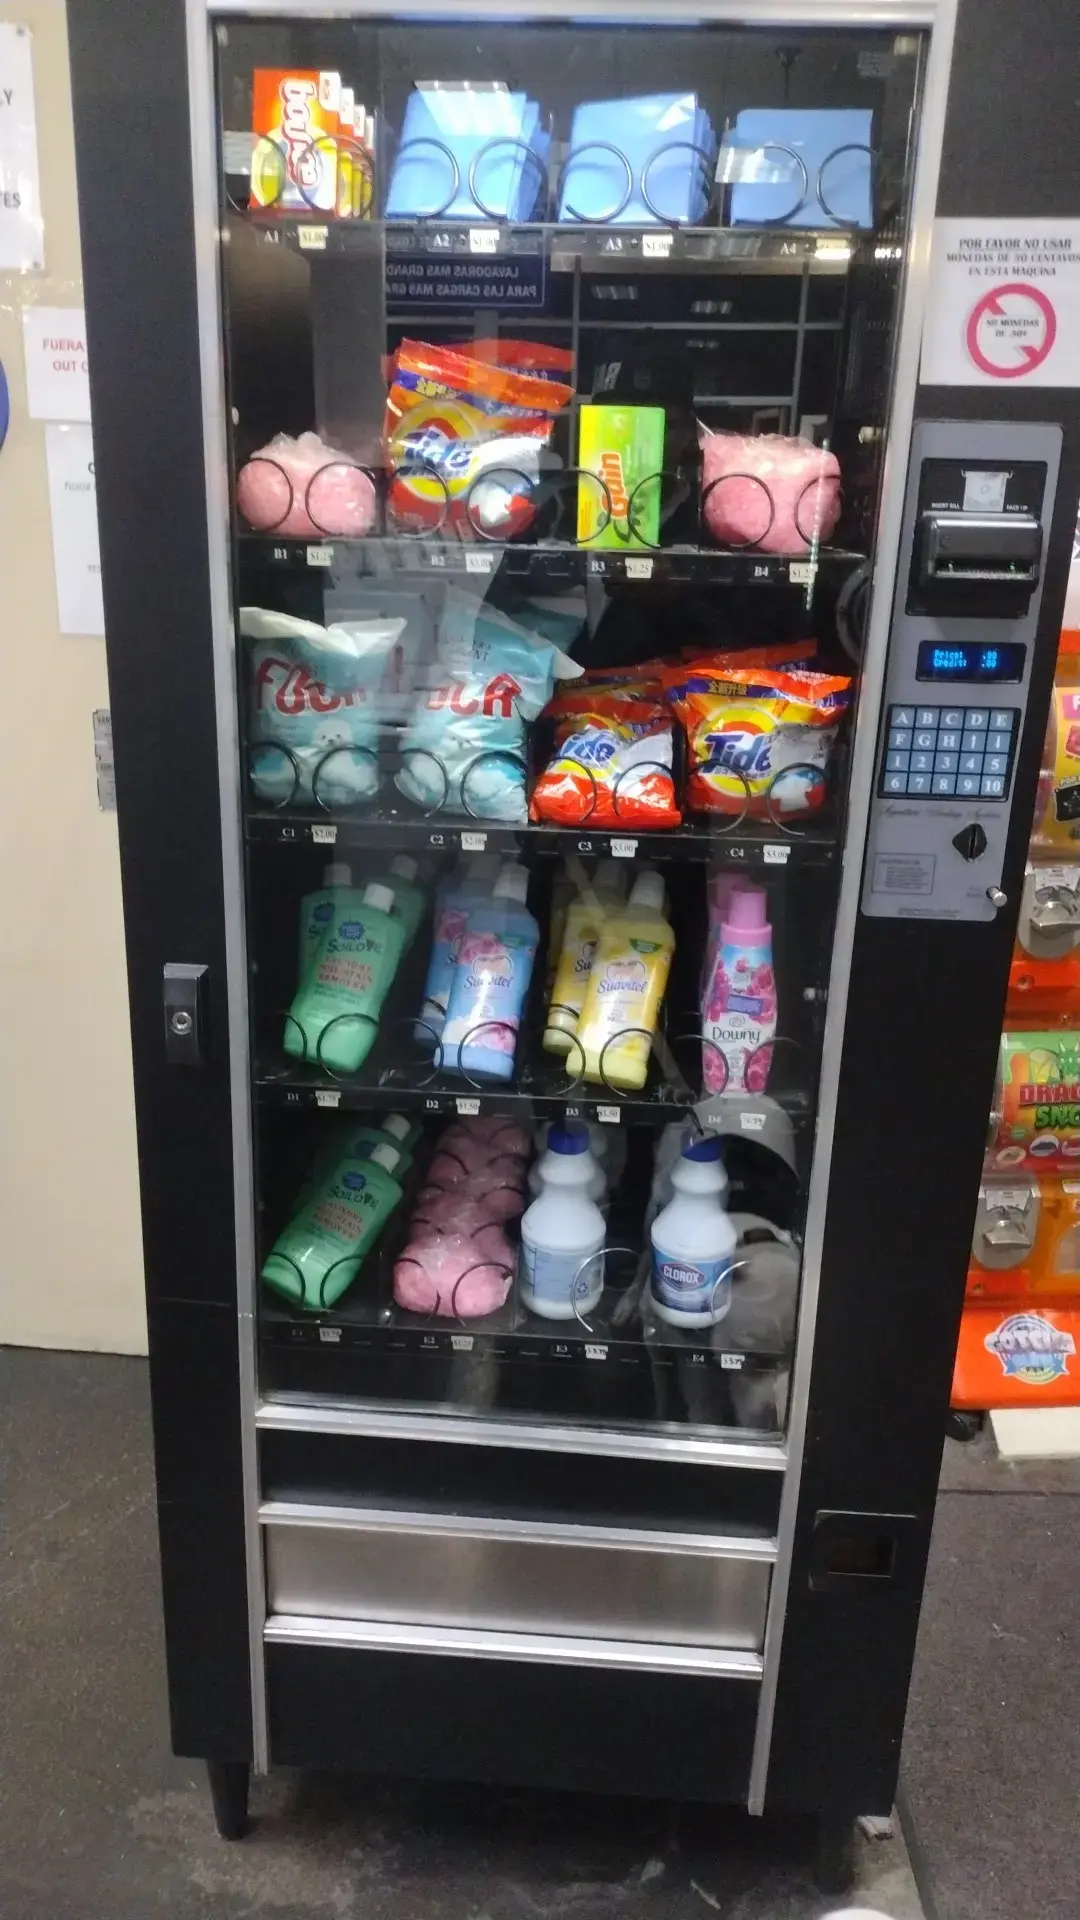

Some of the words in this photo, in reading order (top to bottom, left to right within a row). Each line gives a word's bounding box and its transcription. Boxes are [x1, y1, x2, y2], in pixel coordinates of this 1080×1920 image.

[264, 230, 279, 243] A1
[433, 233, 449, 247] A2
[606, 238, 622, 251] A3
[781, 242, 797, 255] A4
[960, 238, 981, 248] POR
[985, 238, 1020, 249] FAVOR
[1024, 239, 1039, 249] NO
[1043, 239, 1072, 249] USAR
[946, 253, 993, 262] MONEDAS
[997, 253, 1008, 262] DE
[968, 267, 981, 276] EN
[984, 267, 1009, 276] ESTA
[986, 319, 998, 327] NO
[1001, 319, 1039, 327] MONEDAS
[43, 339, 84, 352] FUERA
[53, 360, 77, 373] OUT
[274, 548, 288, 559] B1
[431, 555, 445, 566] B2
[591, 561, 606, 572] B3
[754, 566, 769, 577] B4
[790, 568, 813, 580] $1.2
[934, 659, 967, 667] Credit:
[896, 712, 909, 724] A
[922, 712, 933, 724] B
[945, 713, 958, 725] C
[971, 714, 983, 726] D
[996, 714, 1007, 727] E
[895, 733, 906, 745] F
[918, 735, 931, 747] G
[943, 735, 955, 747] H
[697, 734, 772, 774] Tide
[894, 755, 900, 767] 1
[918, 756, 926, 768] 2
[942, 757, 950, 769] 3
[966, 758, 975, 770] 4
[991, 758, 1000, 771] 5
[891, 777, 900, 789] 6
[915, 778, 924, 790] 7
[939, 779, 948, 790] 8
[964, 779, 973, 791] 9
[985, 780, 1000, 793] 10
[282, 828, 295, 838] C1
[430, 834, 444, 845] C2
[577, 841, 592, 851] C3
[730, 847, 744, 858] C4
[597, 980, 648, 994] Suavitel
[712, 1027, 761, 1044] Downy
[287, 1092, 300, 1101] D1
[426, 1100, 439, 1109] D2
[566, 1108, 579, 1116] D3
[663, 1264, 699, 1284] CLOROX
[692, 1354, 704, 1363] E4
